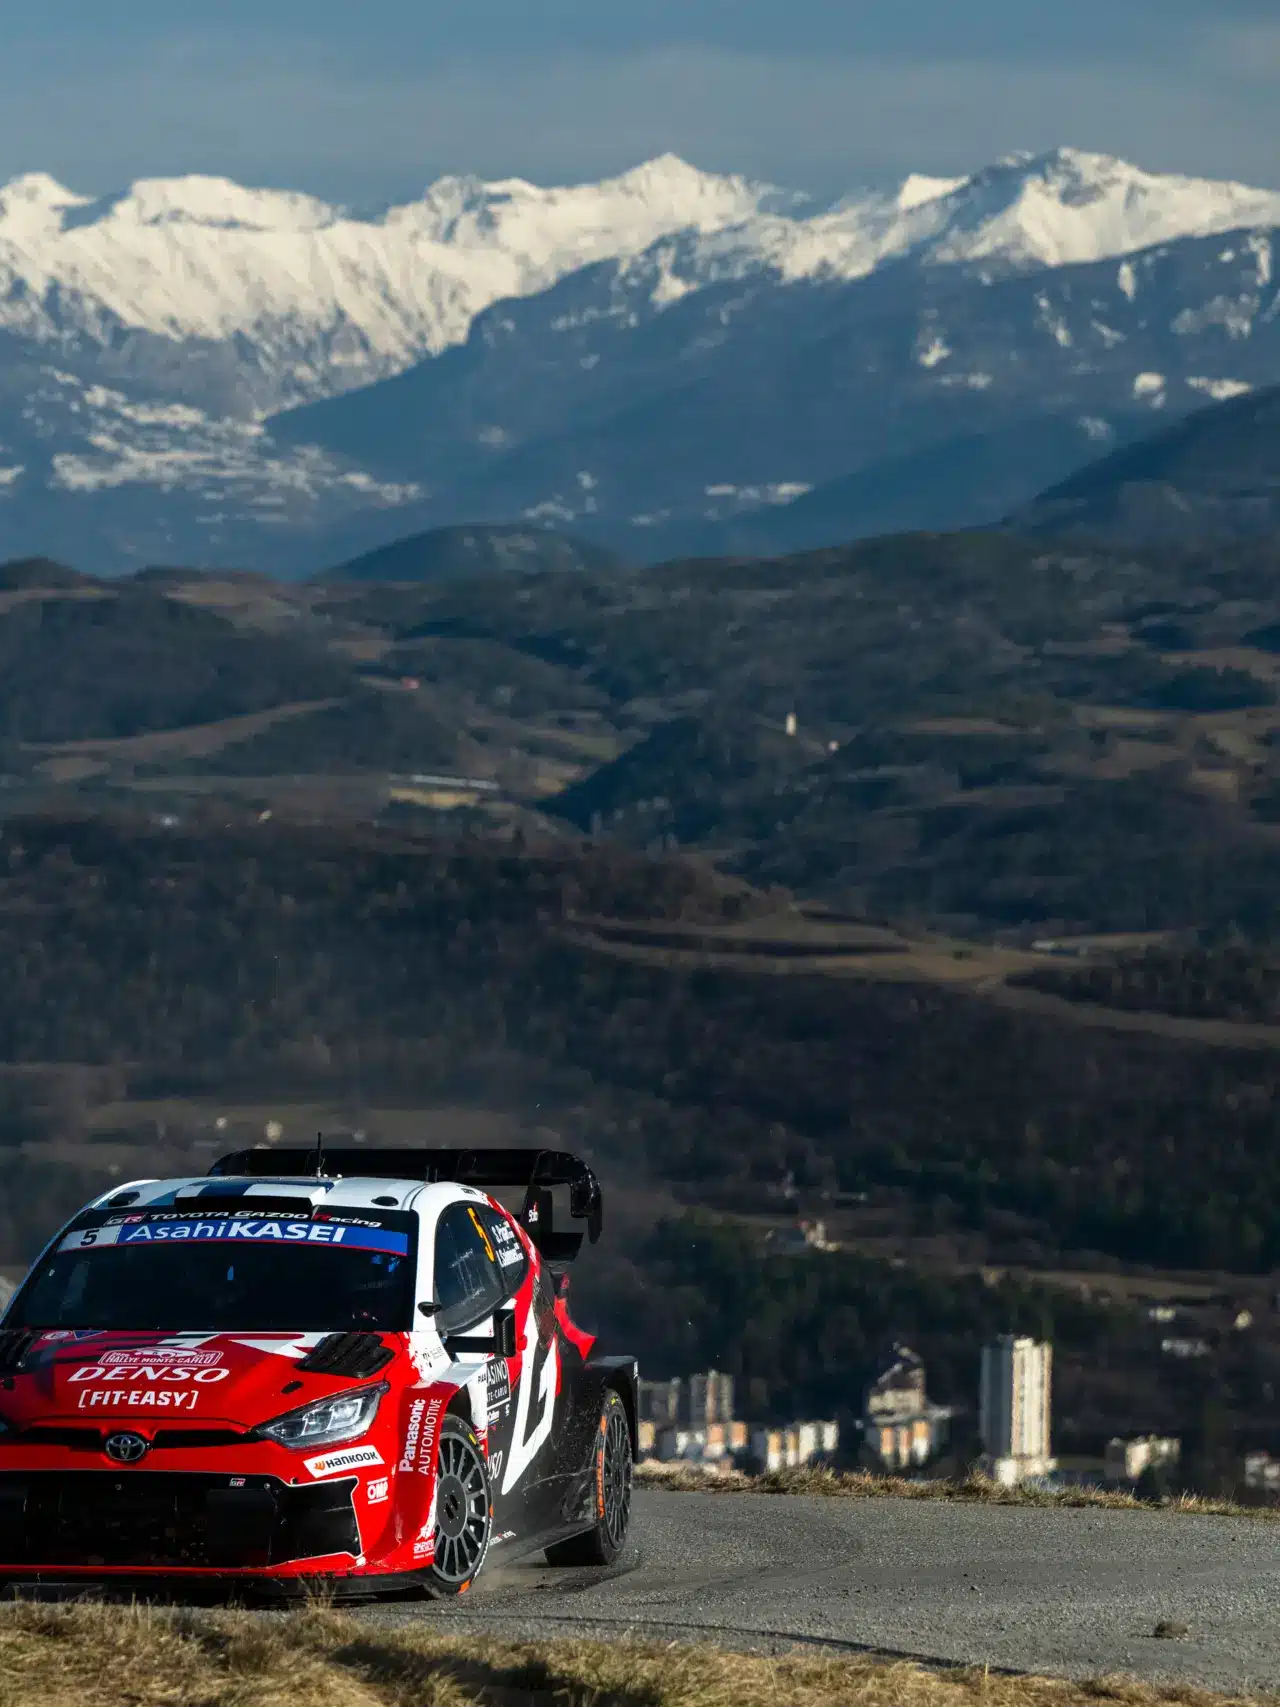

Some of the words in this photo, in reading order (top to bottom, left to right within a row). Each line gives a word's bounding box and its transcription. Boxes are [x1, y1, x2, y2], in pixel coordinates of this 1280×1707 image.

[150, 1211, 229, 1220] TOYOTA
[233, 1210, 309, 1219] GAZOO
[313, 1212, 382, 1228] Racing
[80, 1229, 100, 1246] 5
[106, 1354, 140, 1364] RALLYE
[141, 1355, 212, 1364] MONTE-CARLO
[67, 1366, 230, 1382] DENSO
[487, 1359, 508, 1386] ASINO
[399, 1398, 426, 1472] Panasonic
[418, 1399, 442, 1476] AUTOMOTIVE
[367, 1481, 389, 1499] OMP
